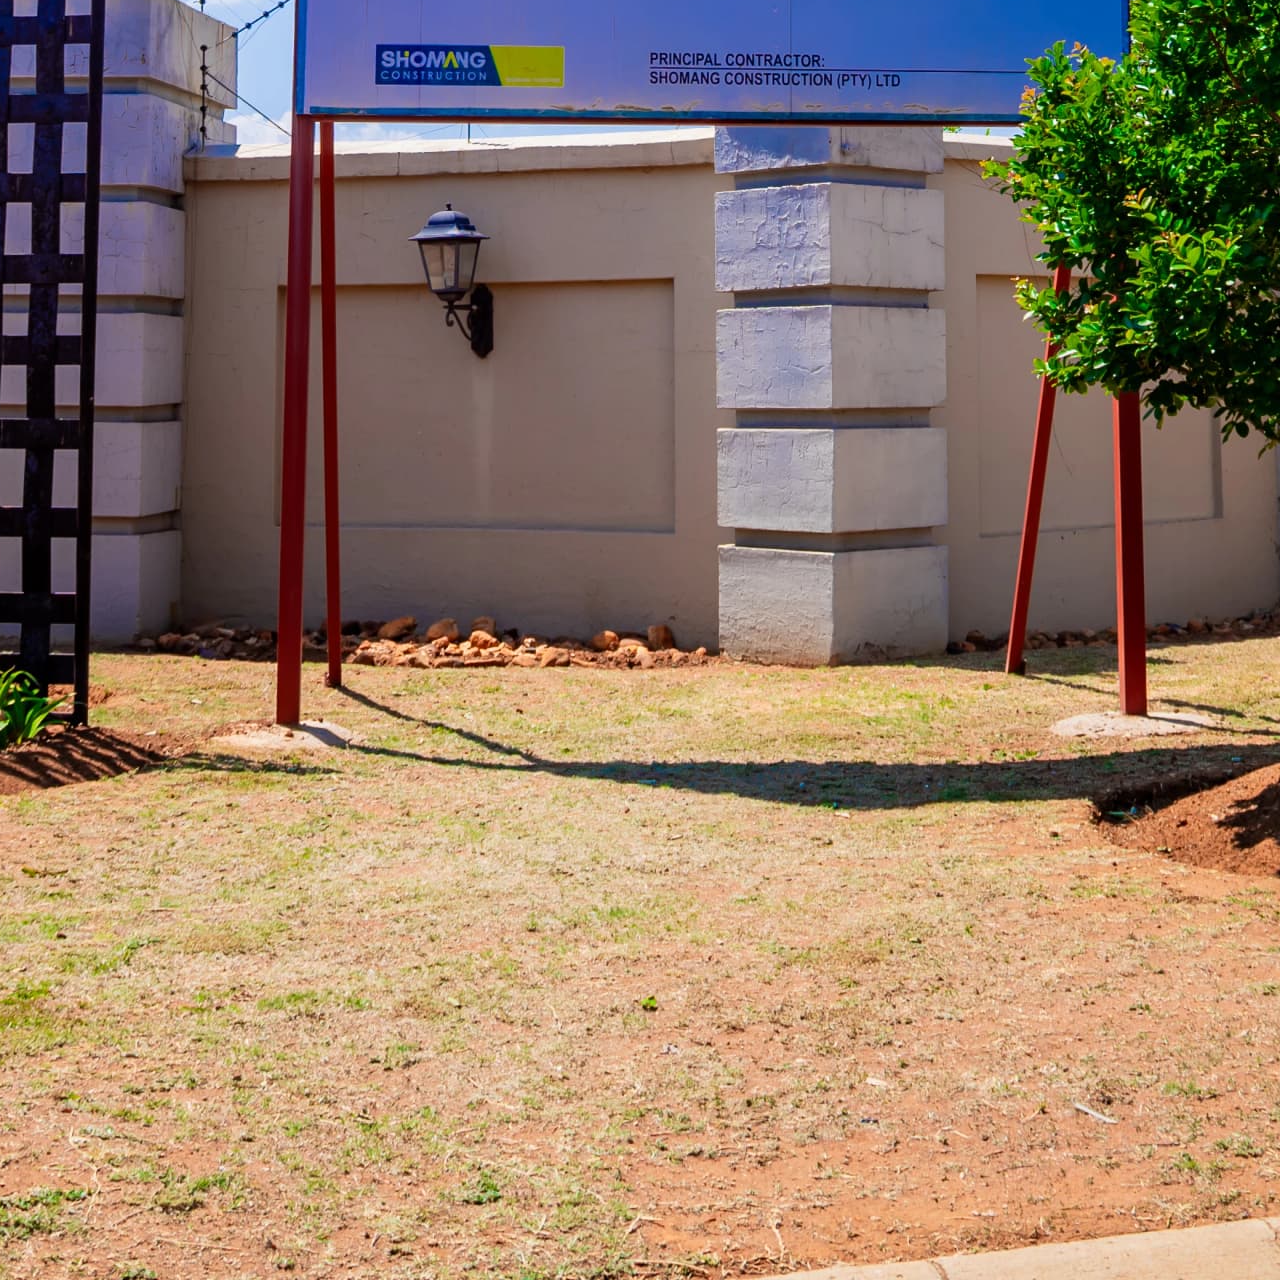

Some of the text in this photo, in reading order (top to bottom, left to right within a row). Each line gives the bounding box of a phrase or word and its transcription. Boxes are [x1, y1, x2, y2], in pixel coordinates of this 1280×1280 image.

[380, 50, 488, 70] SHOMANG
[650, 52, 826, 68] PRINCIPAL CONTRACTOR:
[380, 70, 488, 82] CONSTRUCTION
[649, 71, 901, 90] SHOMANG CONSTRUCTION (PTY) LTD
